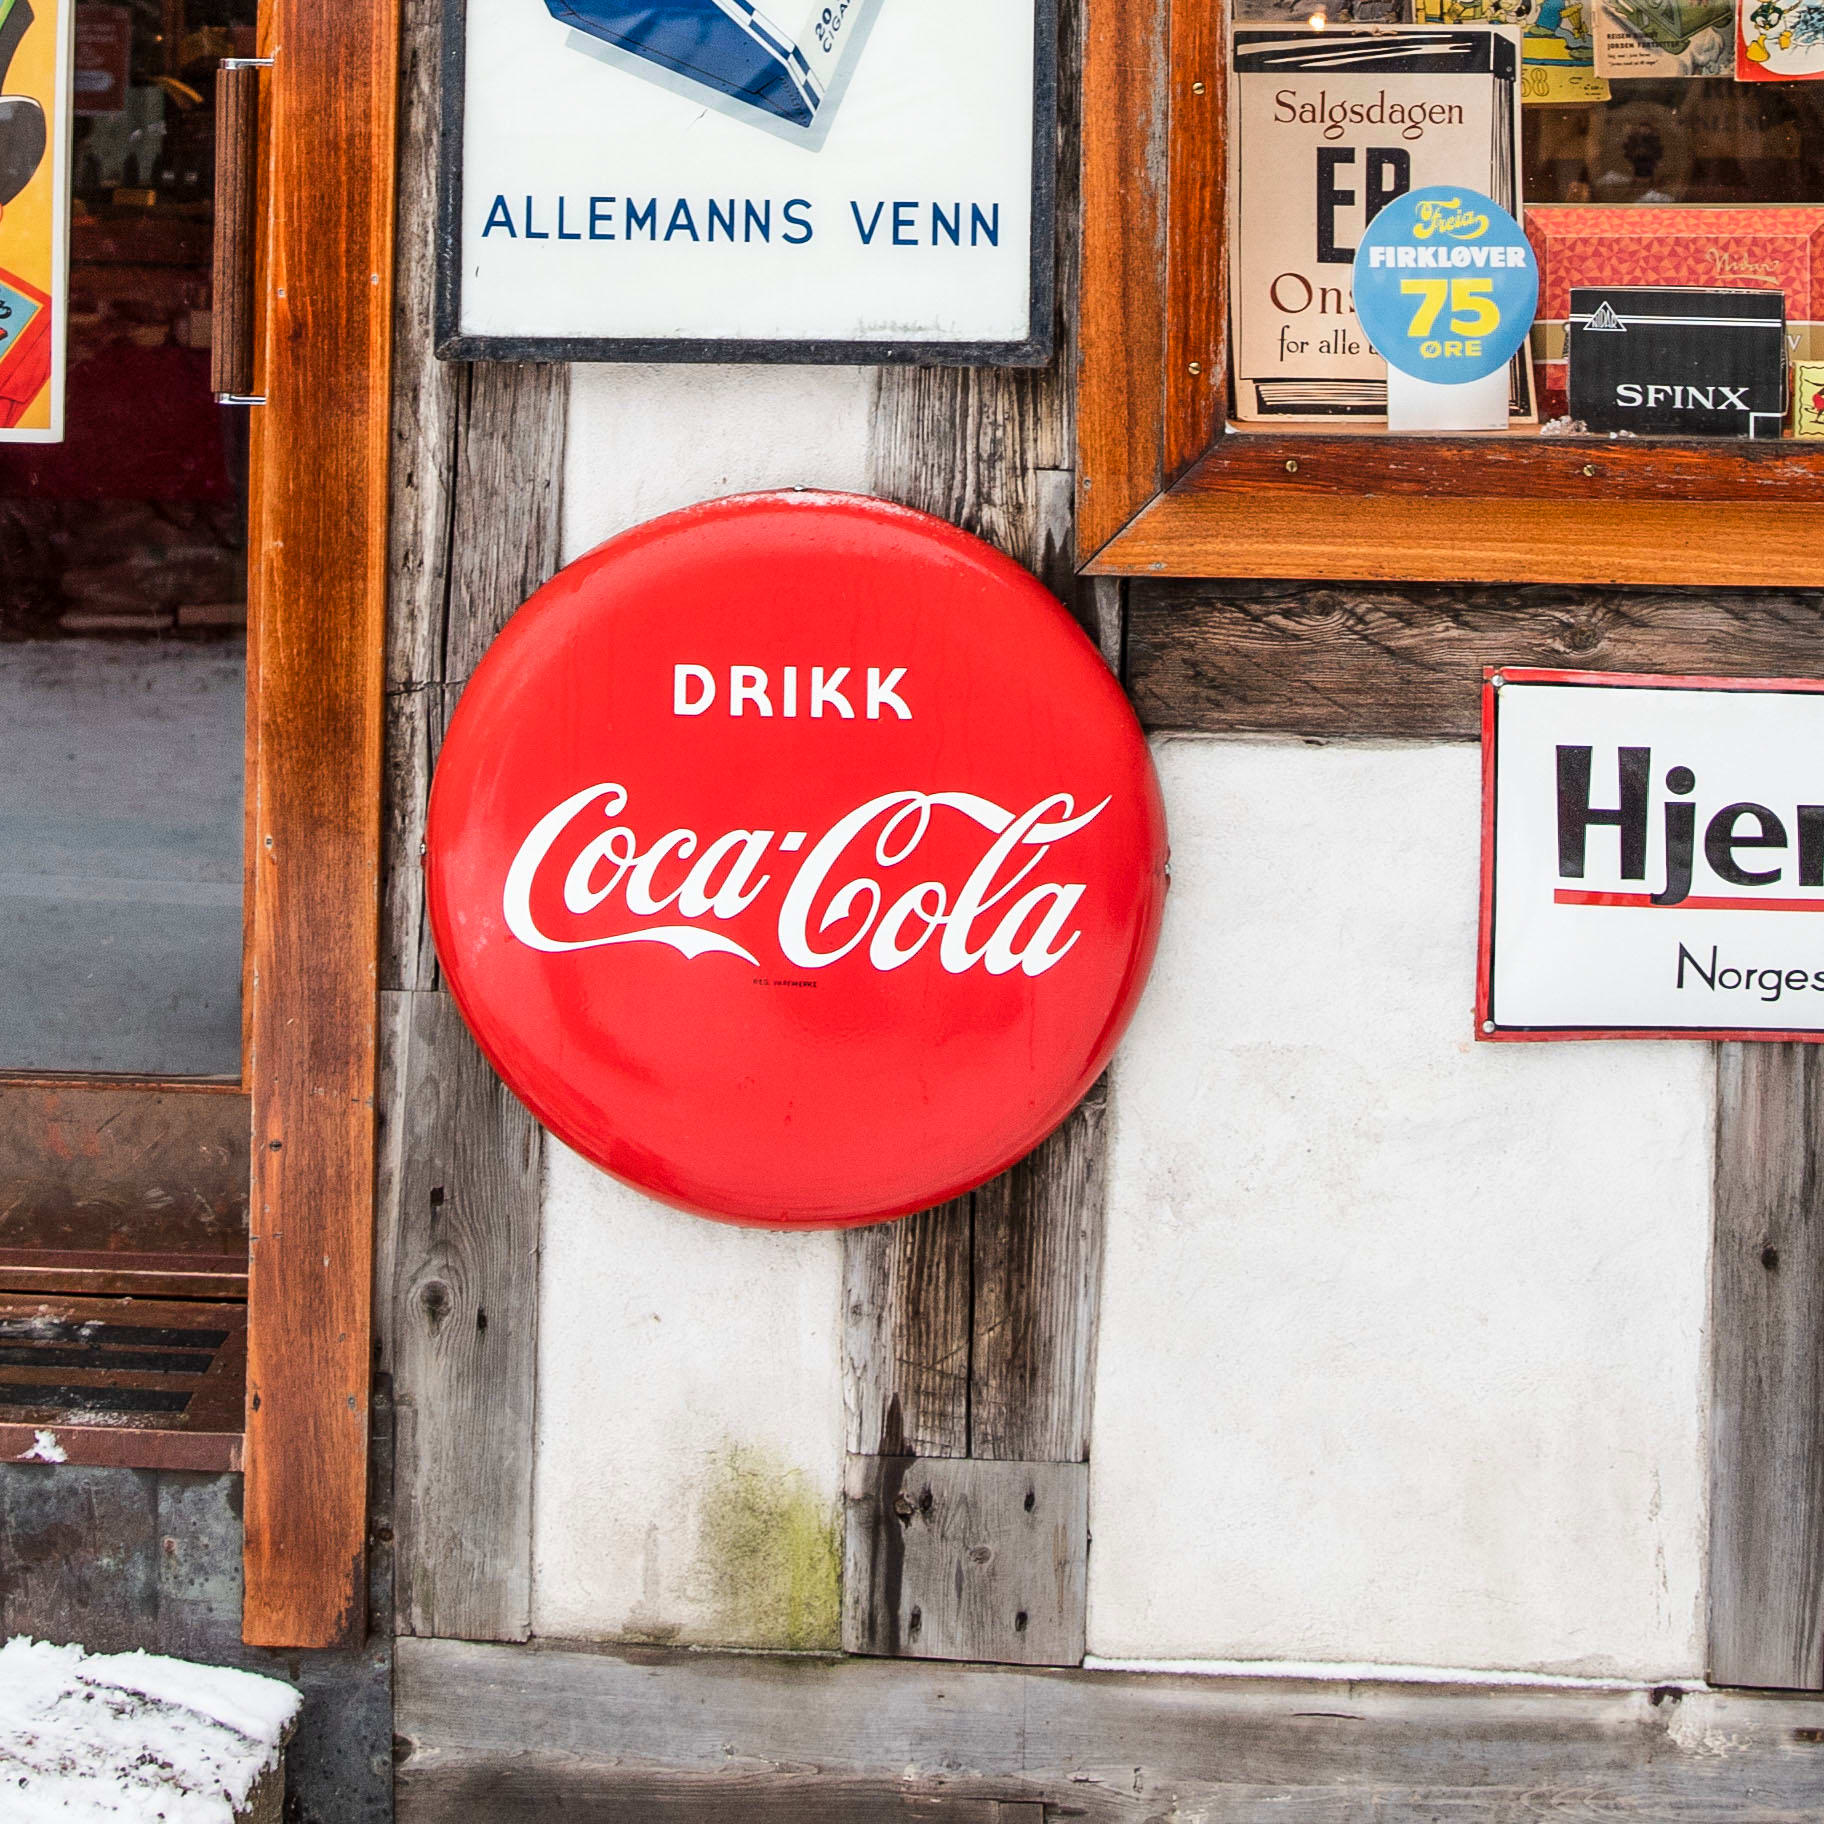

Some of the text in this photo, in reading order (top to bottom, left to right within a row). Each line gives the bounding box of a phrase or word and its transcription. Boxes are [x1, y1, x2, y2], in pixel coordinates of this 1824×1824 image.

[814, 7, 833, 42] 20
[1274, 89, 1465, 140] Salgsdagen
[481, 194, 1001, 248] ALLEMANNS VENN
[1413, 197, 1490, 240] Freia
[1368, 245, 1526, 268] FIRKLØVER
[1270, 272, 1355, 315] On
[1400, 278, 1501, 337] 75
[1279, 325, 1310, 363] for
[1318, 328, 1361, 356] alle
[1419, 340, 1482, 358] ØRE
[1616, 383, 1751, 410] SFINX
[673, 663, 913, 721] DRIKK
[503, 782, 1113, 977] Coca-Cola
